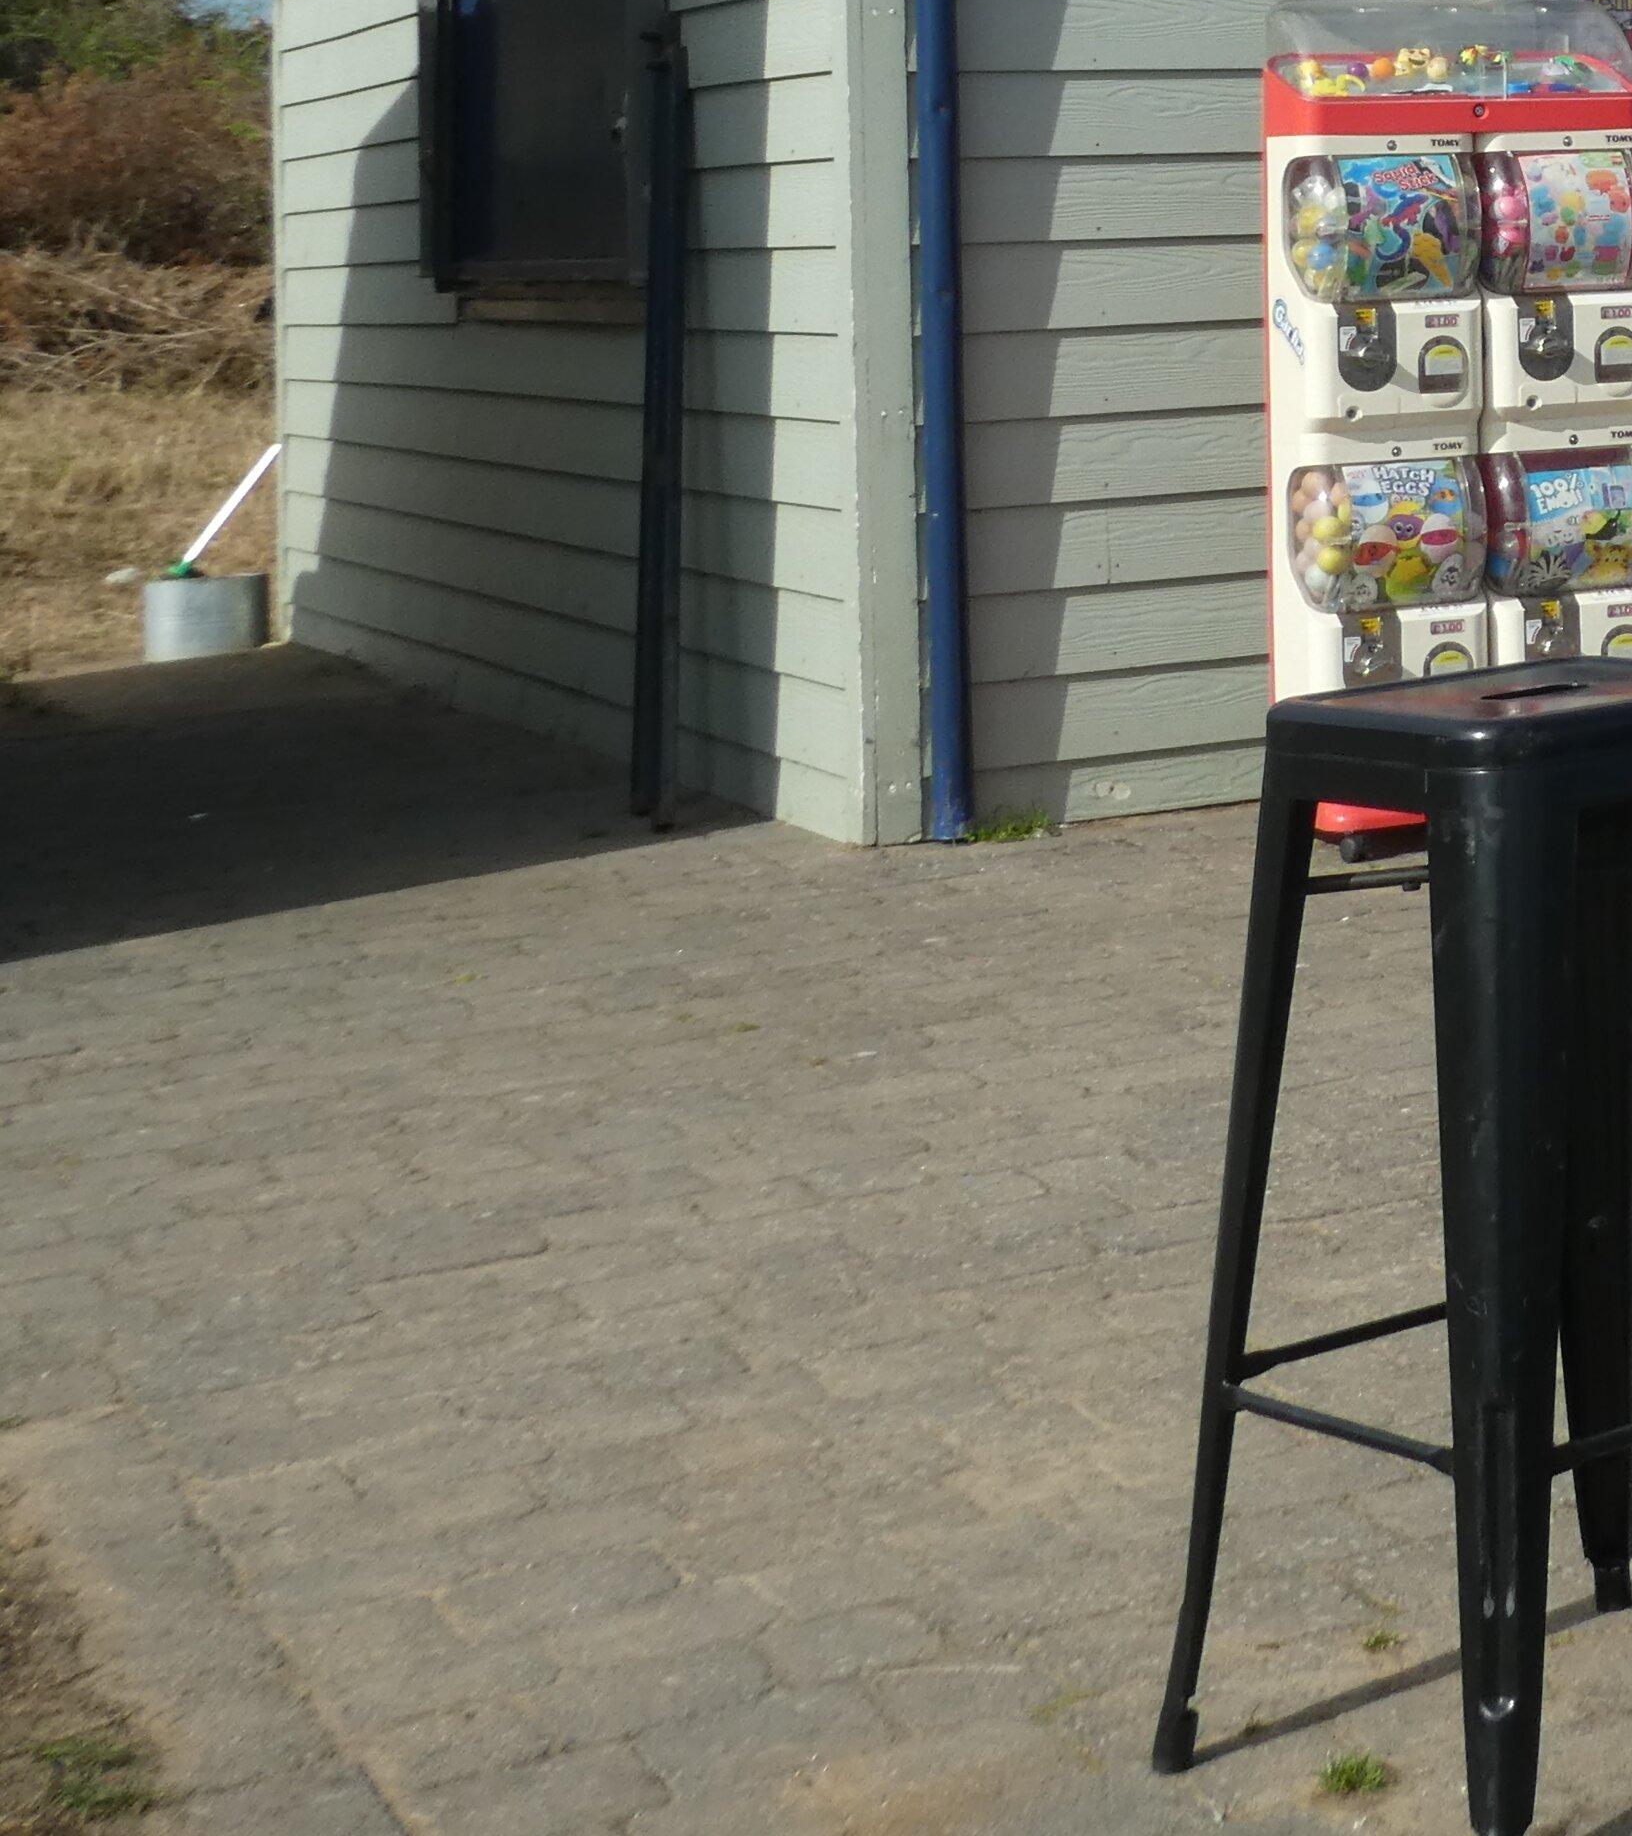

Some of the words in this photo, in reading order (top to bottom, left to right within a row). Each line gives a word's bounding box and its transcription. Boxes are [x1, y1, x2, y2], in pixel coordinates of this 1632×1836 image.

[1431, 138, 1460, 147] TOMY
[1432, 443, 1463, 451] TOMY
[1372, 465, 1436, 484] HATCH
[1381, 481, 1432, 497] EGGS
[1530, 473, 1584, 499] 100%
